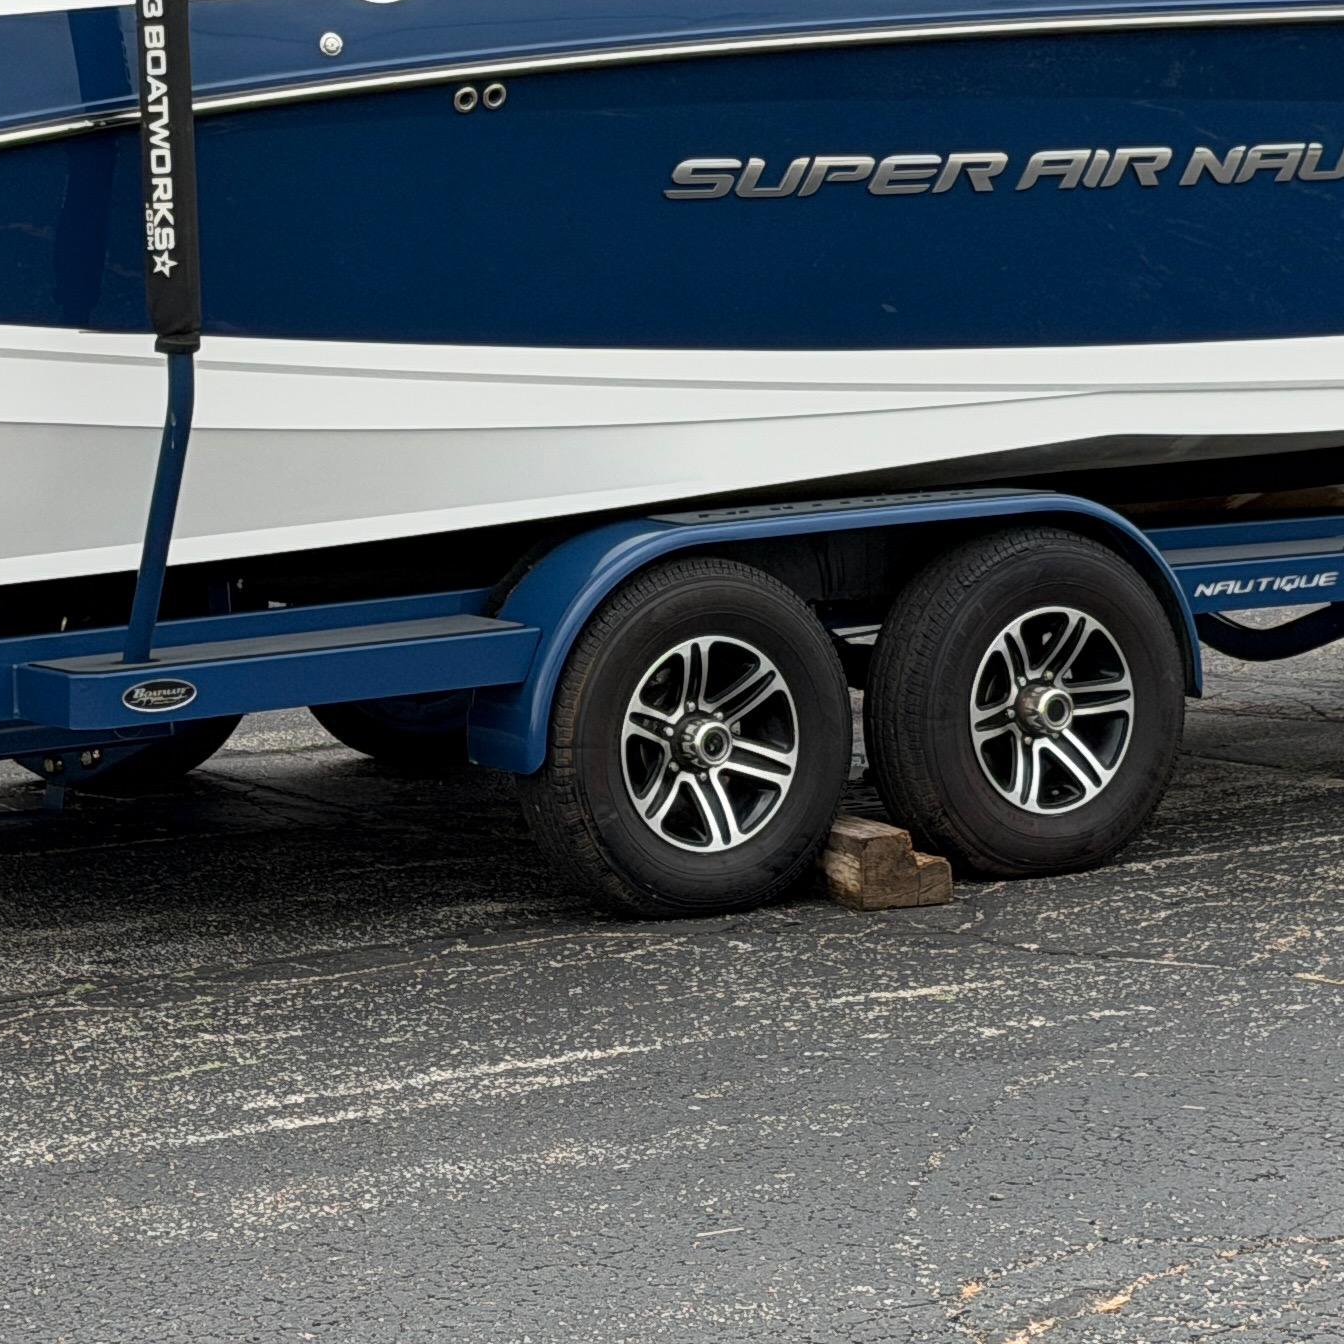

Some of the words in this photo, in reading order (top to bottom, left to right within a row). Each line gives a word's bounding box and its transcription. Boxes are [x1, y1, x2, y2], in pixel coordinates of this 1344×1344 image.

[144, 24, 176, 251] BOATWORKS
[662, 151, 1009, 200] SUPER
[1016, 146, 1174, 192] AIR
[1193, 571, 1340, 598] NAUTIQUE
